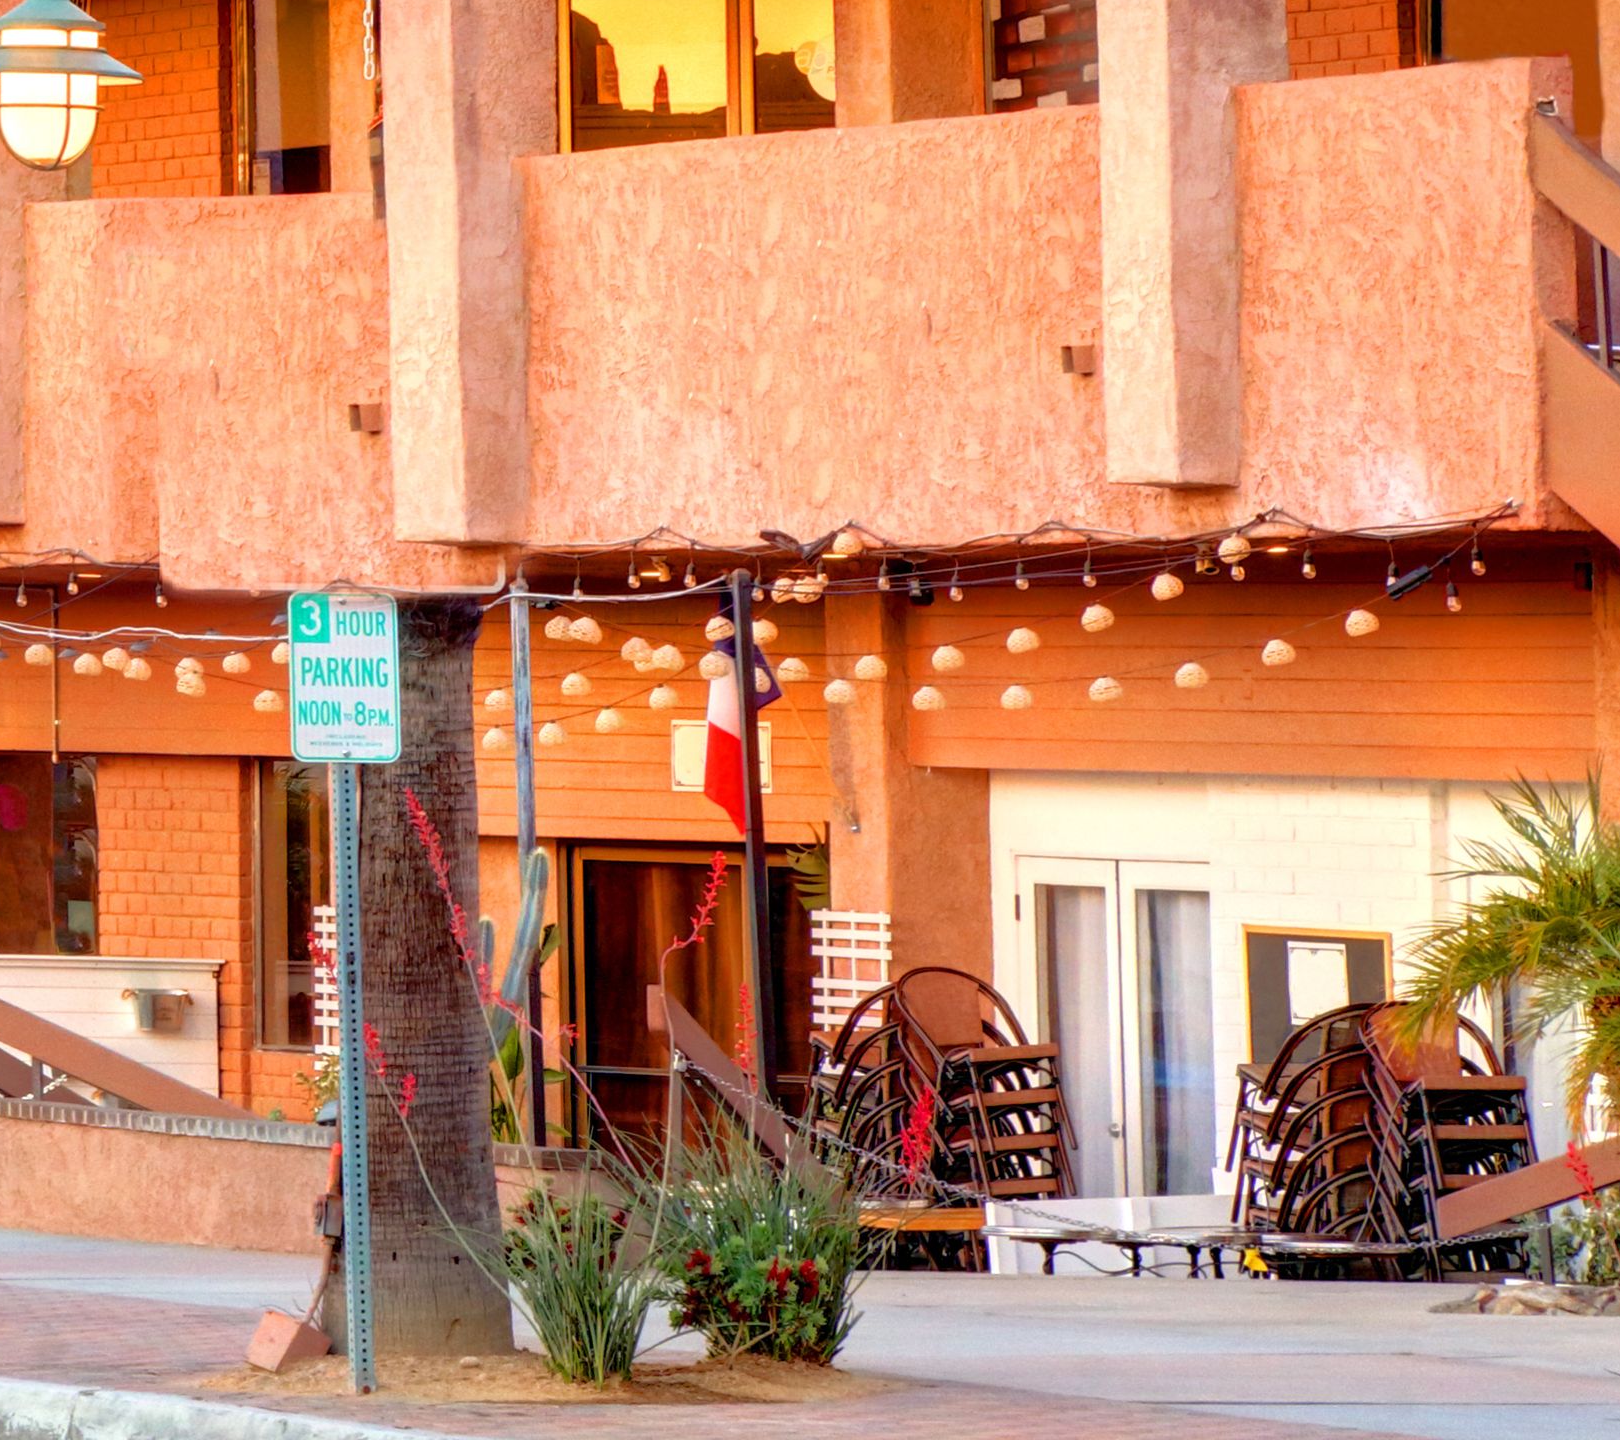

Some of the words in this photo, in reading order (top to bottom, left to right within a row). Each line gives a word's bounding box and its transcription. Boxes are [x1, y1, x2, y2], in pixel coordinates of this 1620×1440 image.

[299, 600, 322, 636] 3
[336, 610, 387, 637] HOUR
[300, 656, 389, 688] PARKING
[298, 700, 342, 726] NOON
